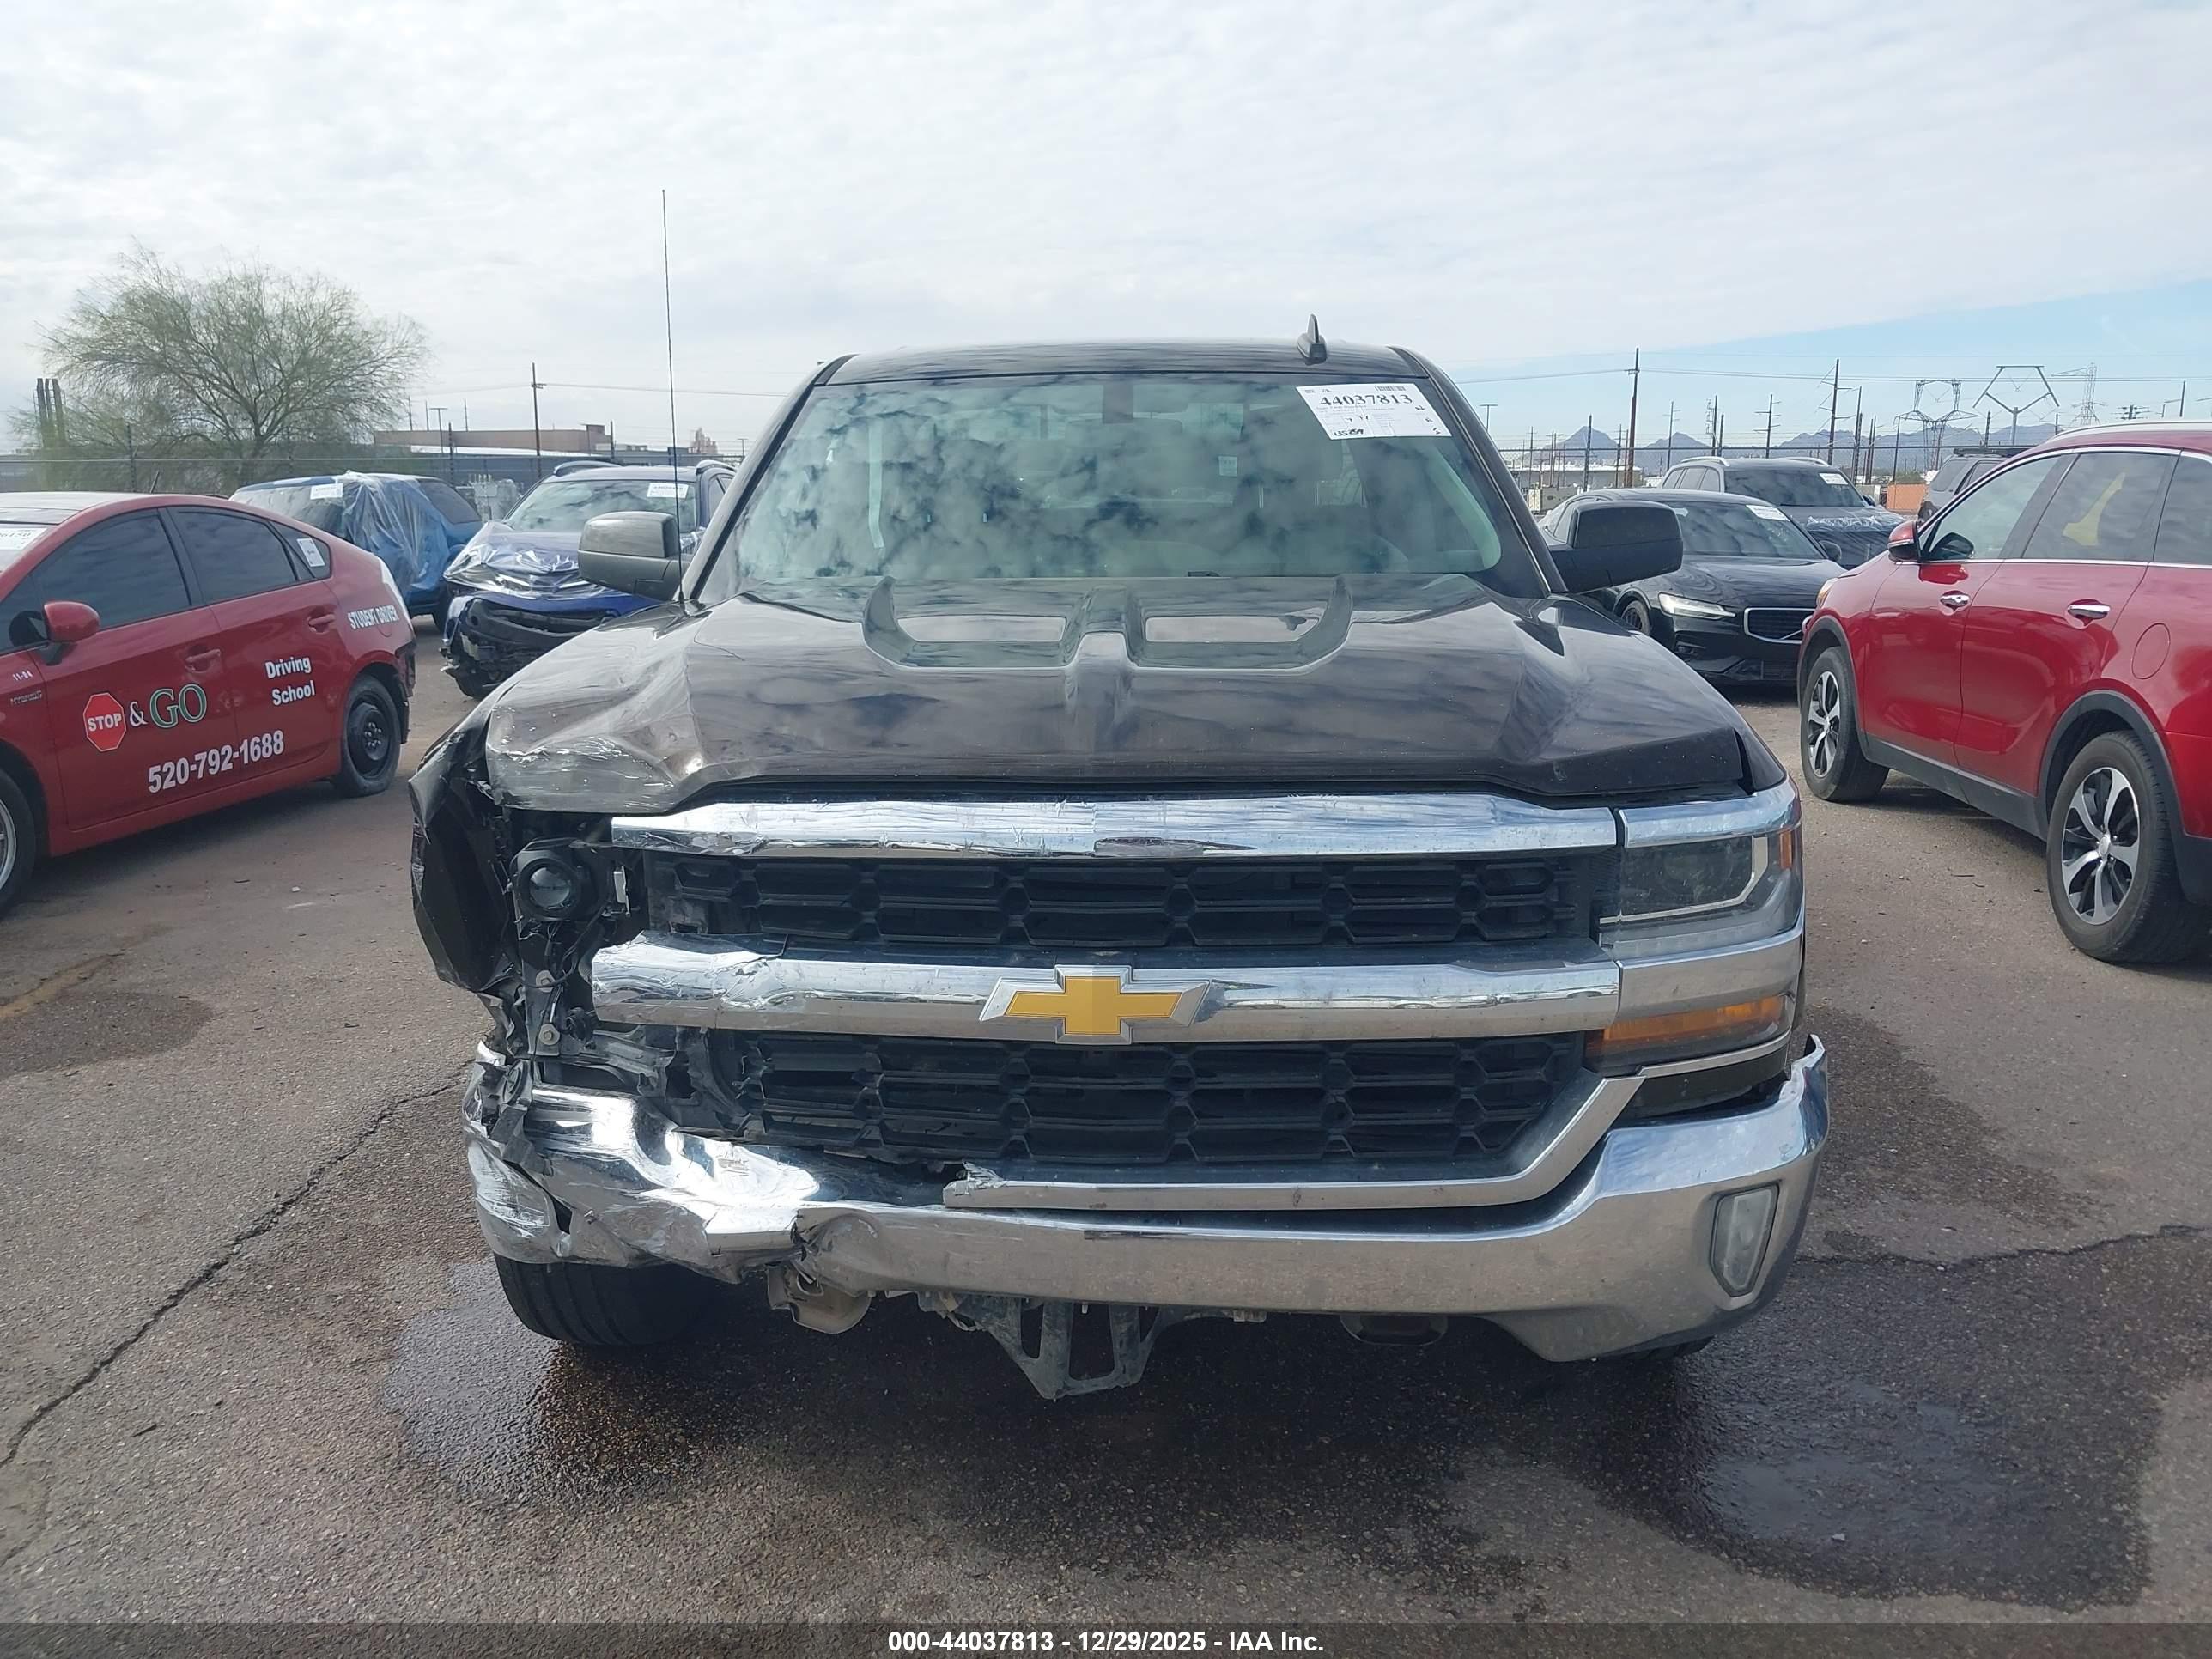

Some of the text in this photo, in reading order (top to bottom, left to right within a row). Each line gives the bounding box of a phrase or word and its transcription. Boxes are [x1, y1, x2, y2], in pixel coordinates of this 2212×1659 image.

[1320, 394, 1413, 406] 44037813
[348, 605, 399, 629] STUDENT DRIVER
[265, 656, 312, 679] Driving
[272, 680, 315, 706] School
[88, 684, 207, 732] STOP & GO
[148, 730, 284, 793] 520-792-1688
